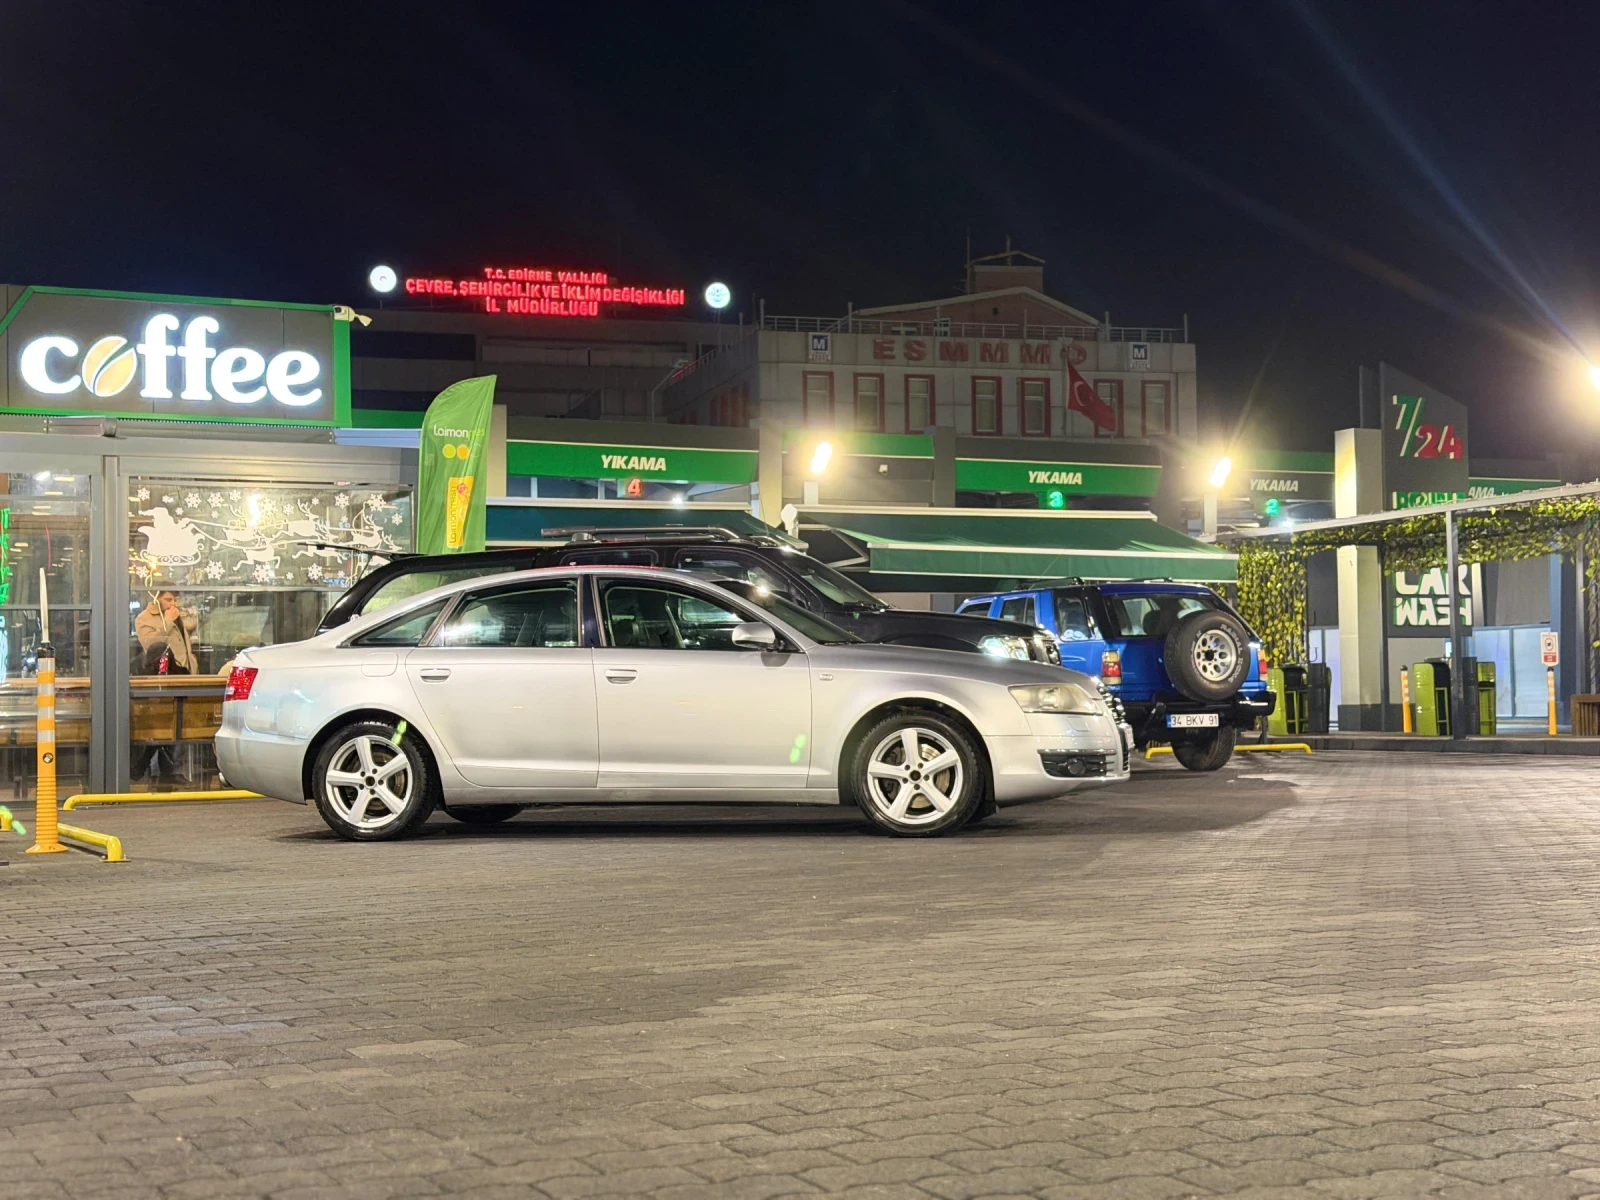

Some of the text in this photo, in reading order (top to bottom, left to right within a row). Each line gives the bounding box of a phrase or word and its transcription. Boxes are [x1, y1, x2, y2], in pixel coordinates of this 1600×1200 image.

[508, 267, 553, 282] EDİRNE
[542, 284, 560, 299] VE
[20, 313, 323, 407] coffee
[1393, 394, 1464, 462] 7/24
[601, 454, 667, 471] YIKAMA
[1028, 470, 1083, 485] YIKAMA
[1249, 479, 1299, 493] YIKAMA
[627, 478, 642, 497] 4
[1467, 486, 1495, 499] AMA
[1049, 491, 1064, 508] 3
[1266, 498, 1279, 516] 2
[1394, 596, 1473, 627] WASH
[1171, 715, 1182, 726] 34
[1186, 715, 1205, 726] BKV
[1208, 715, 1218, 726] 91
